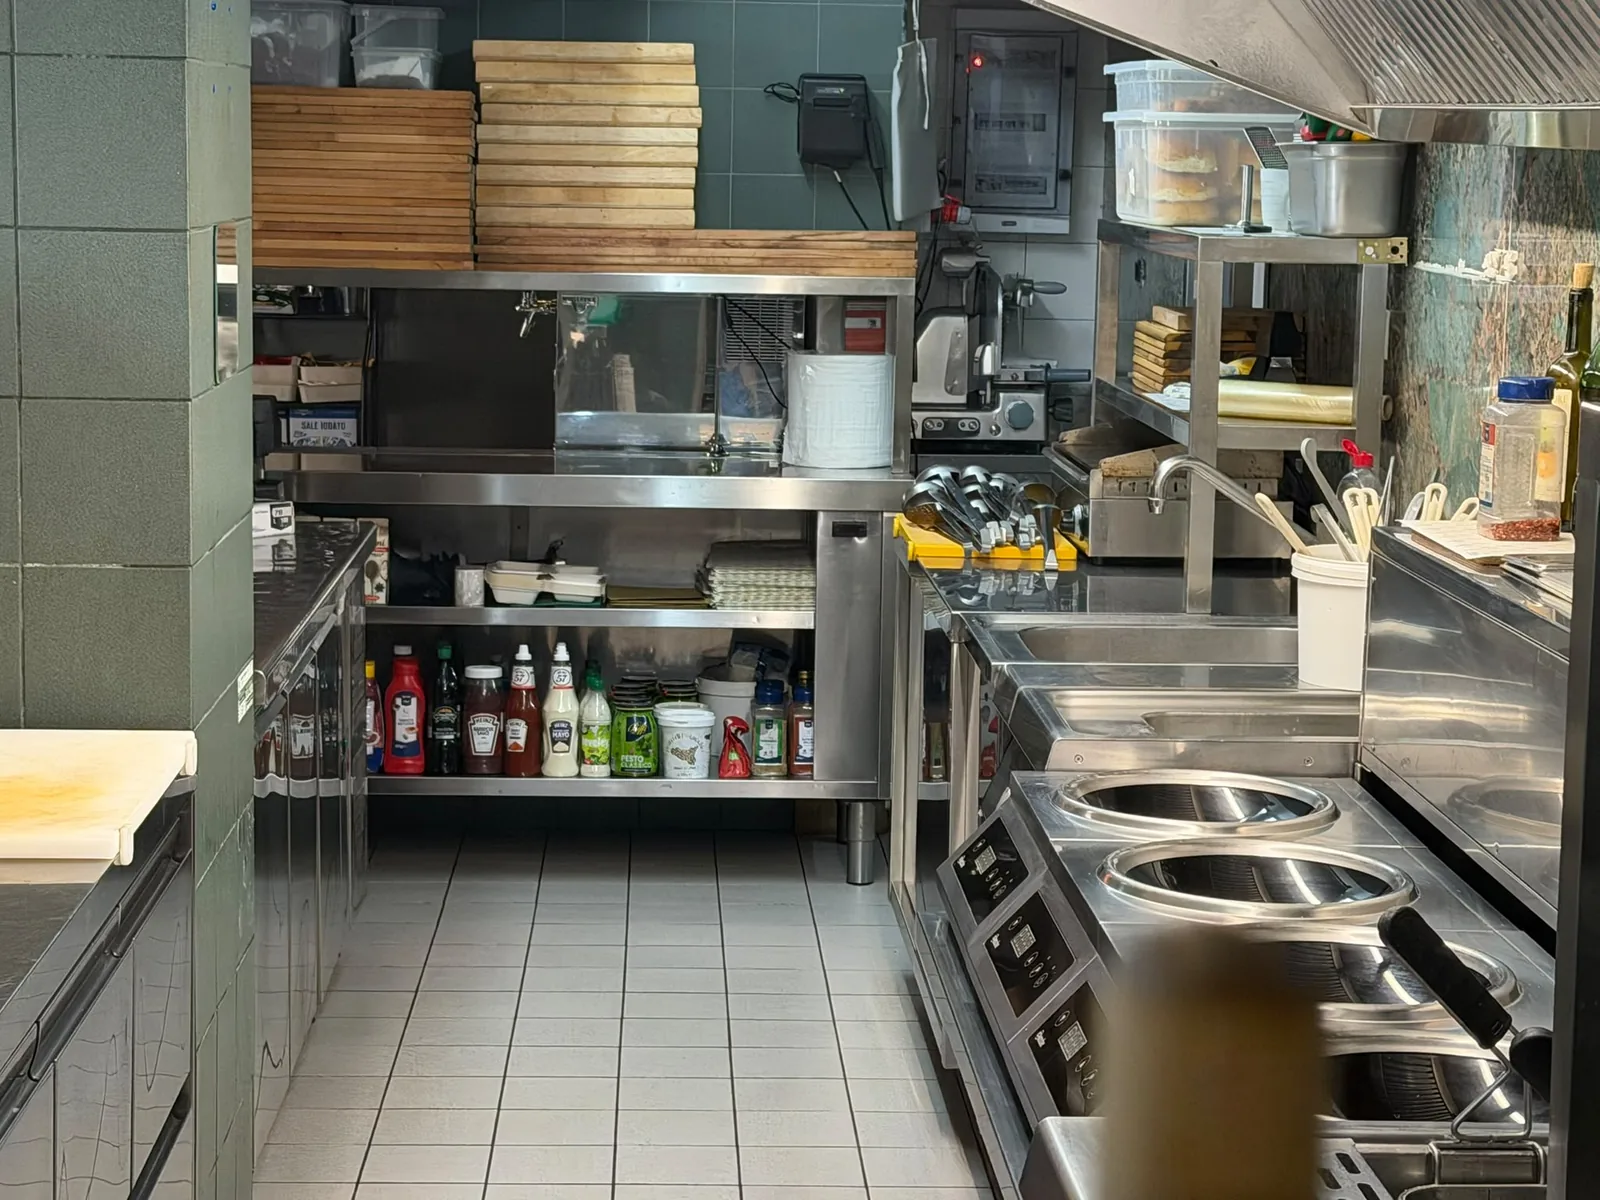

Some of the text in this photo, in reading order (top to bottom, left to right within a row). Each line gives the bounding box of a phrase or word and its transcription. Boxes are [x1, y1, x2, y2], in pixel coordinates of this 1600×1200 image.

[301, 421, 346, 430] SALE IODATO
[514, 674, 525, 682] 57
[555, 674, 567, 683] 57
[552, 731, 570, 739] MAYO
